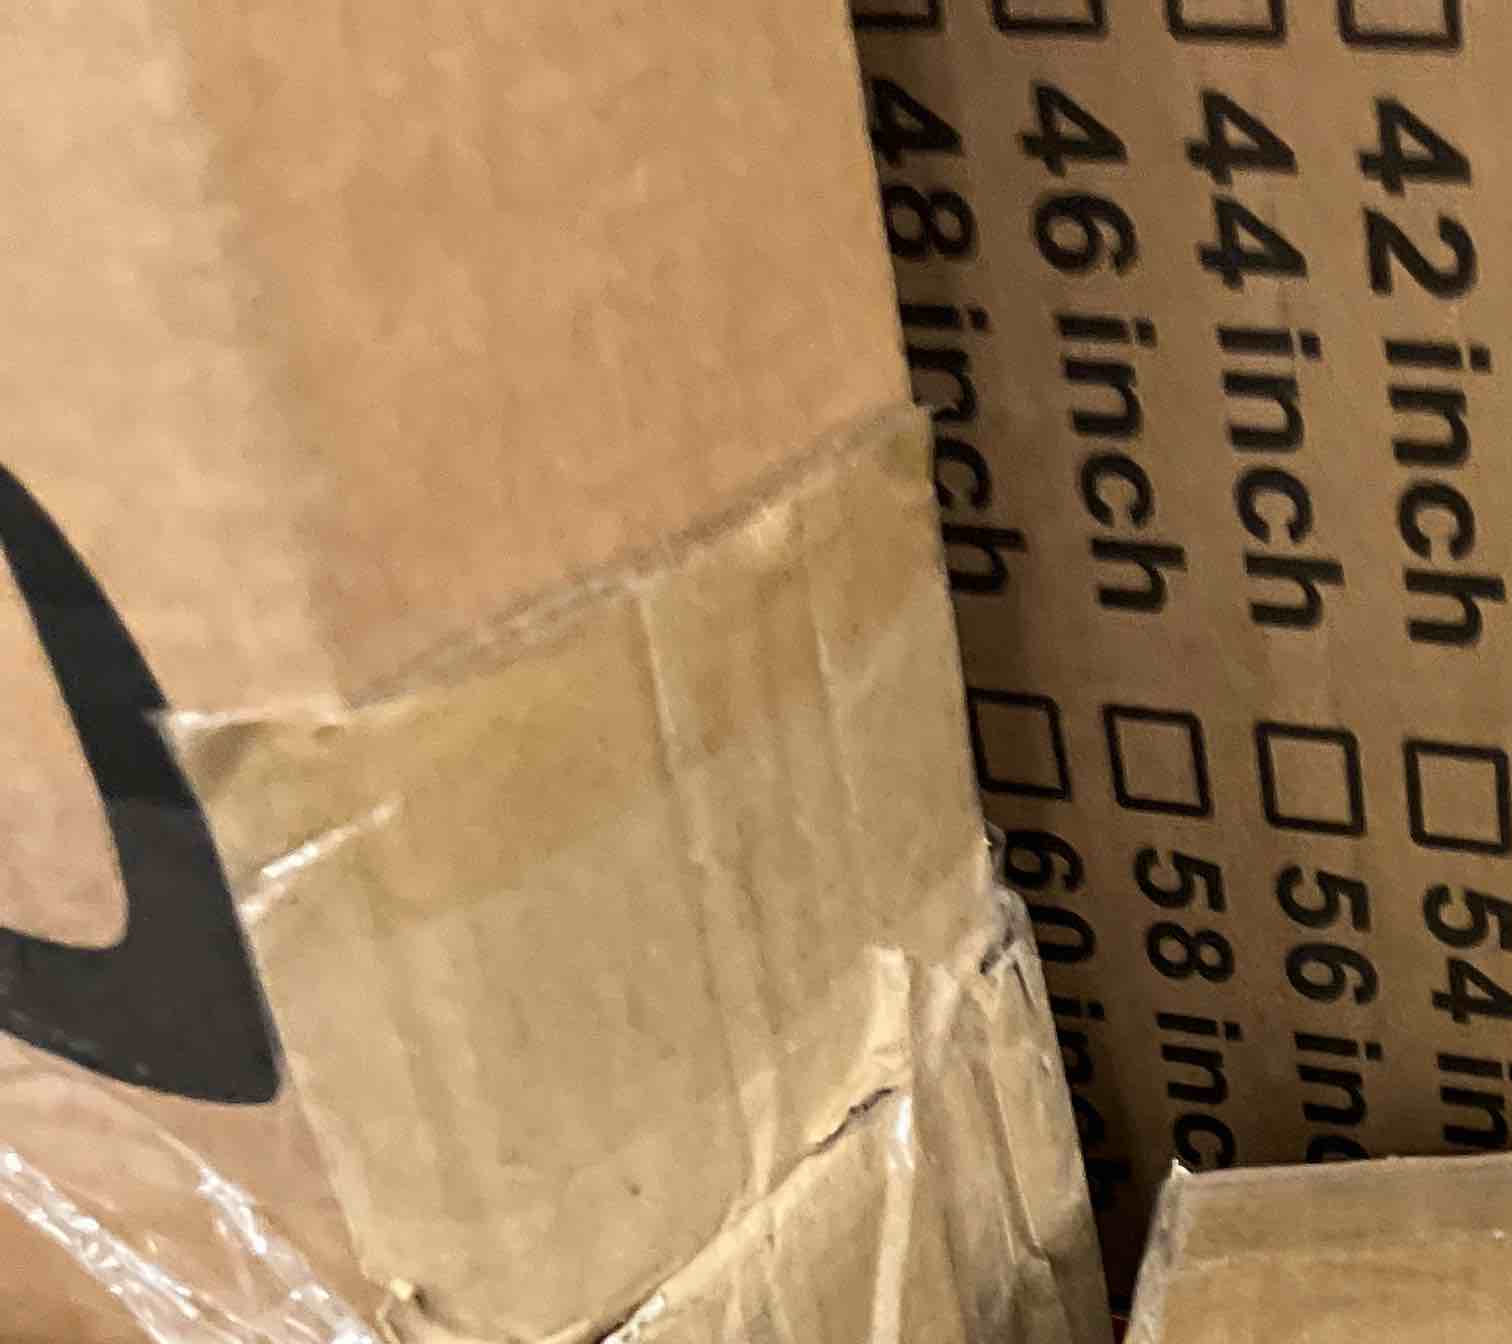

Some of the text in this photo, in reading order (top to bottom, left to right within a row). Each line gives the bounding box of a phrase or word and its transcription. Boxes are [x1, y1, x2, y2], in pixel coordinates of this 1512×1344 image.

[869, 76, 1026, 594] 48 inch
[1015, 80, 1187, 613] 46 inch
[1185, 88, 1346, 630] 44 inch
[1358, 95, 1507, 647] 42 inch
[1003, 829, 1096, 964] 60
[1133, 846, 1242, 1168] 58 inc
[1275, 866, 1378, 1006] 56
